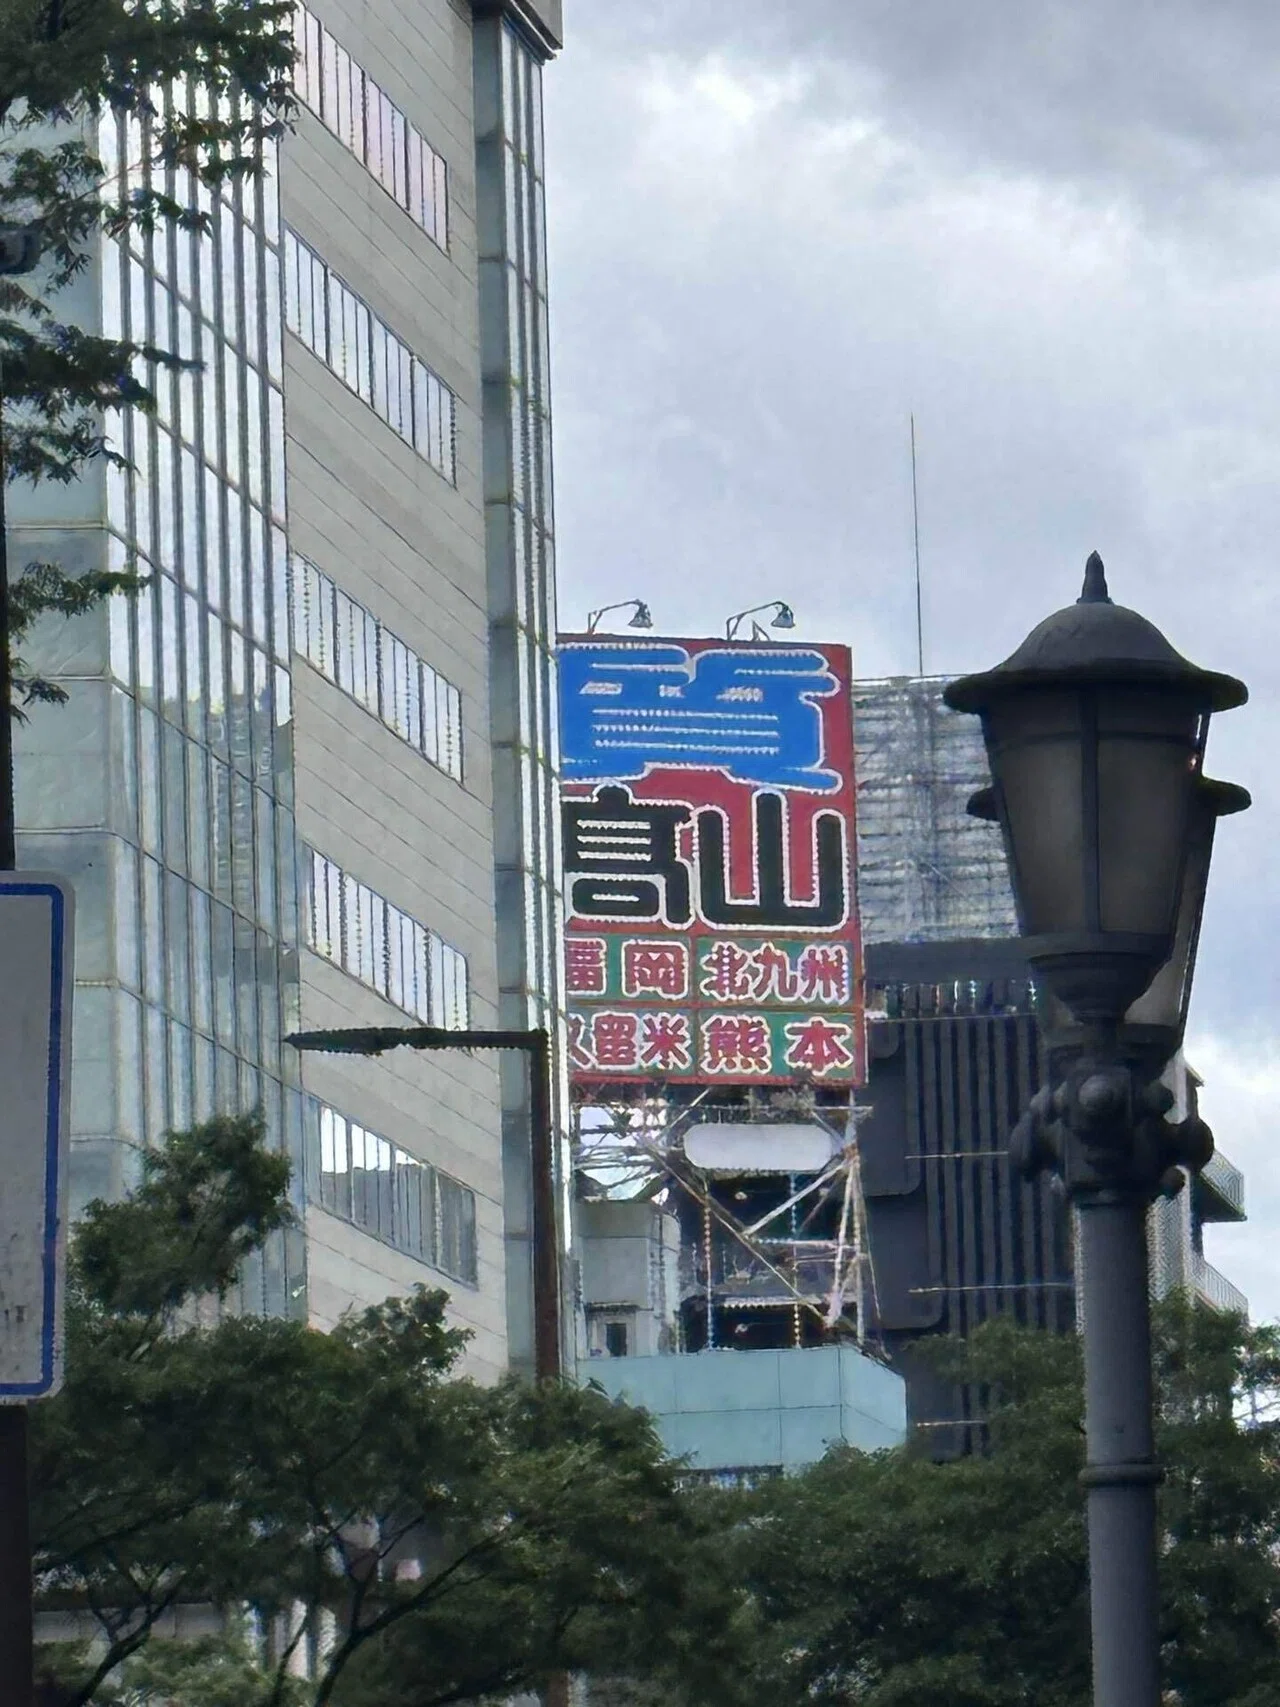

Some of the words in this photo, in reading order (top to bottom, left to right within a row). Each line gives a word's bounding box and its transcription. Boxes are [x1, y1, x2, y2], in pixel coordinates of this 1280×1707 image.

[556, 643, 843, 794] 質
[564, 780, 849, 931] 高山
[700, 942, 850, 1004] 北九州
[700, 1014, 853, 1075] 熊本
